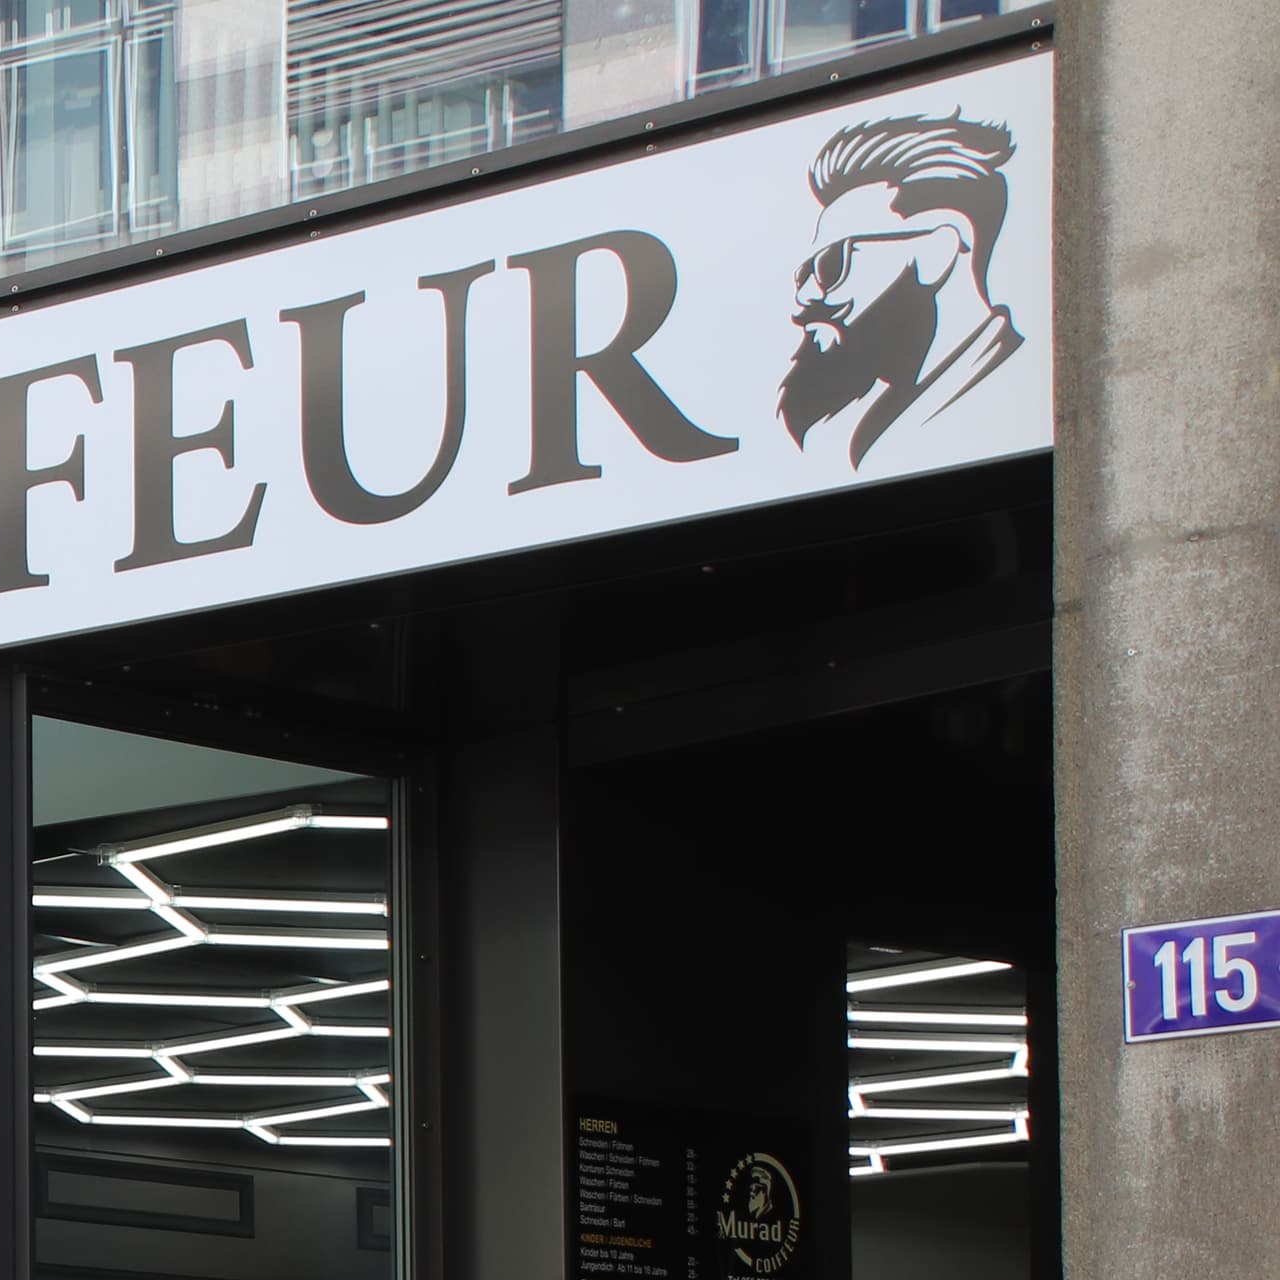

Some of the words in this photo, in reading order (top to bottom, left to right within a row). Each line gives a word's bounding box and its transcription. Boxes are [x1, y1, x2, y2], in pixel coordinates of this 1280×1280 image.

[1154, 931, 1258, 1020] 115
[579, 1117, 617, 1134] HERREN
[719, 1211, 782, 1243] Murad
